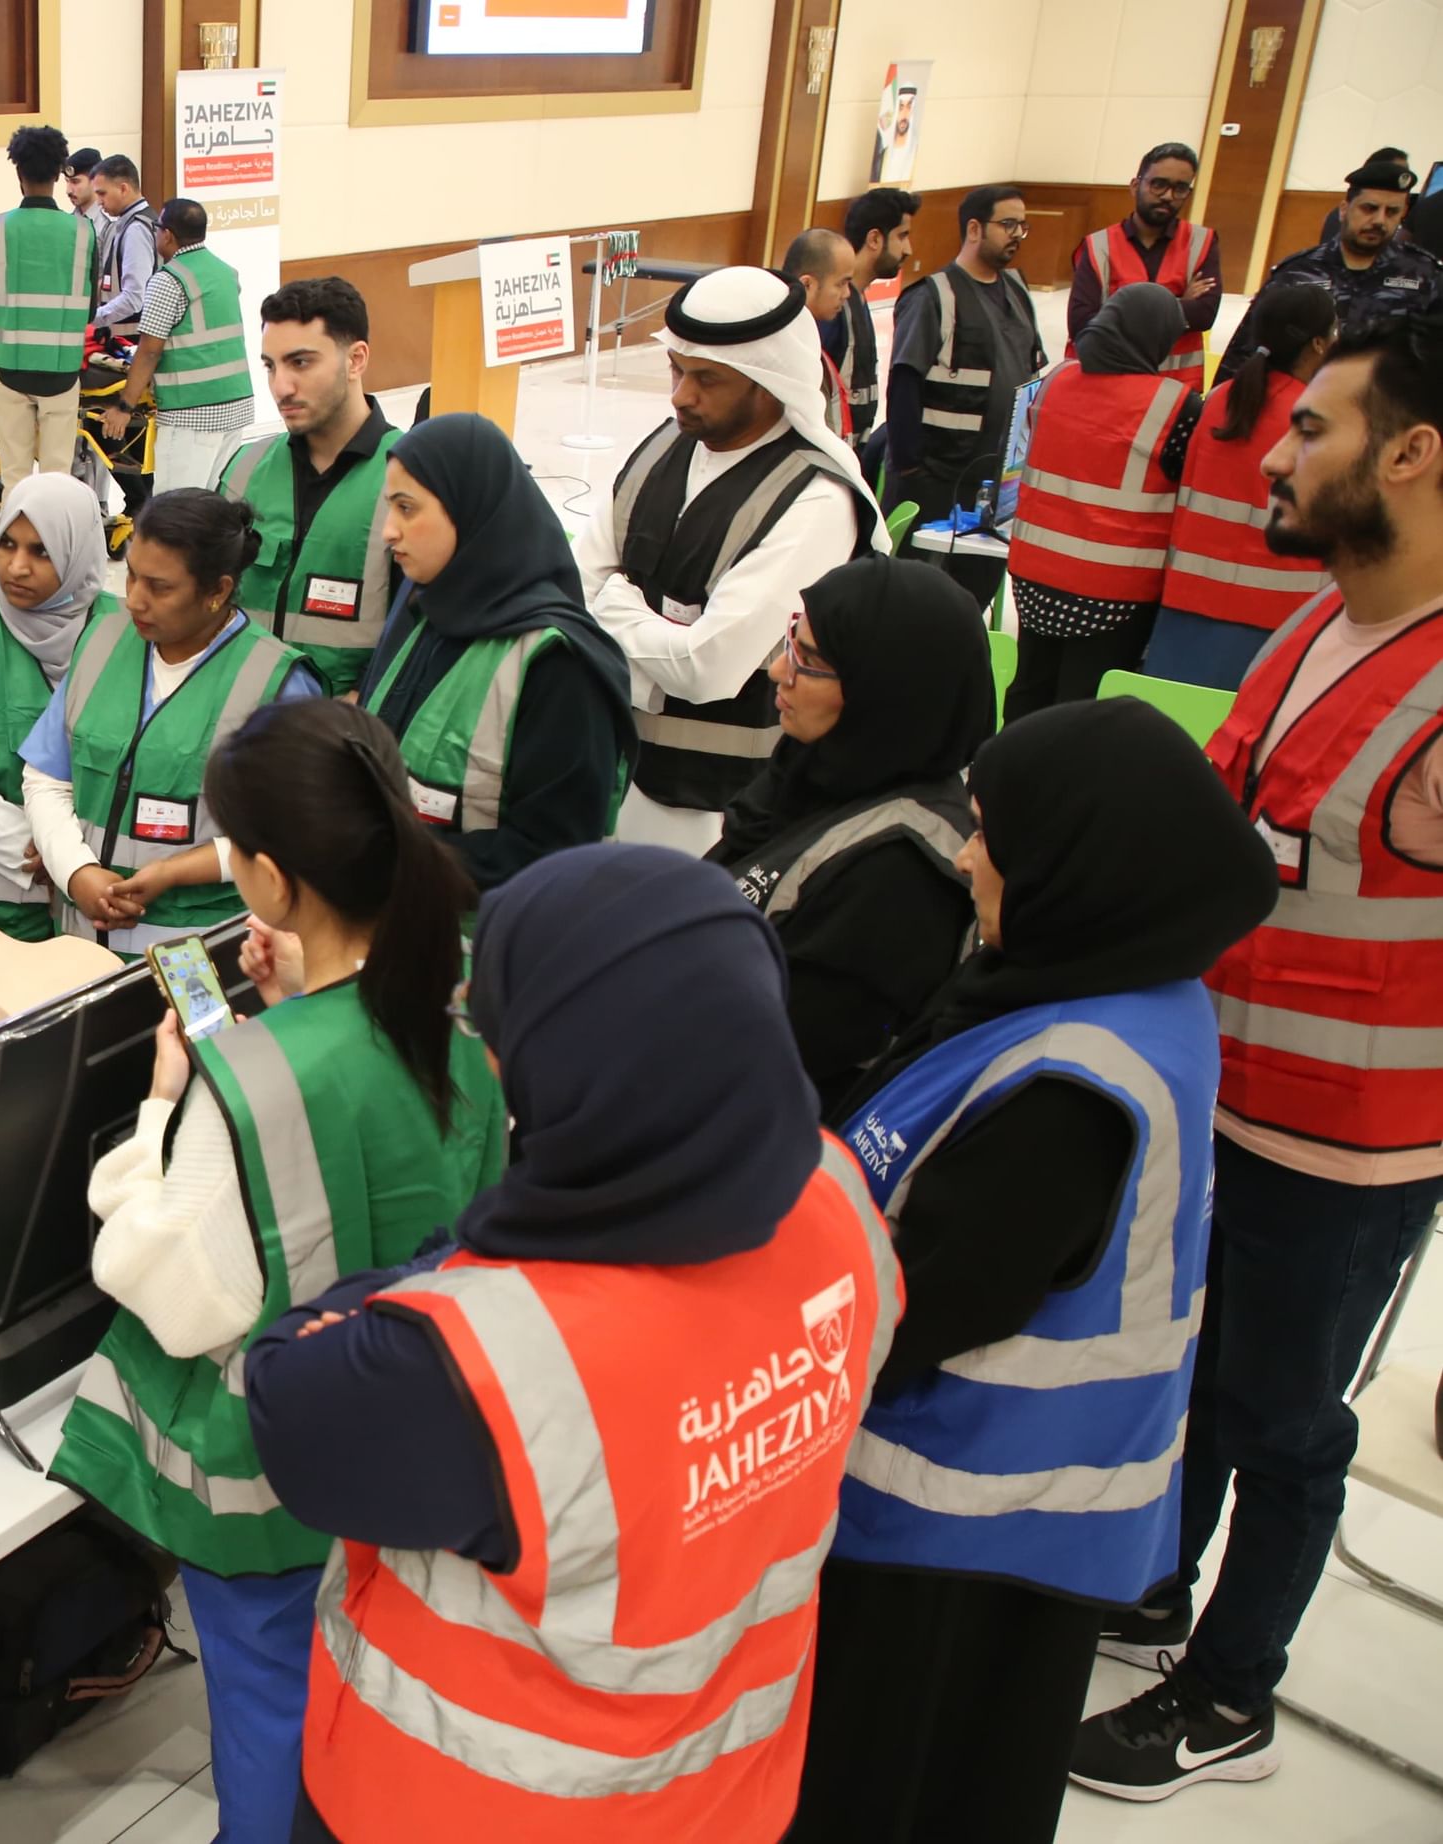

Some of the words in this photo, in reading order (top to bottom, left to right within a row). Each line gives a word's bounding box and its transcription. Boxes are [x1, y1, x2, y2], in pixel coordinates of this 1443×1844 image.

[184, 102, 274, 124] JAHEZIYA
[494, 272, 561, 298] JAHEZIYA
[678, 1347, 814, 1444] جاهزية
[682, 1368, 851, 1513] JAHEZIYA
